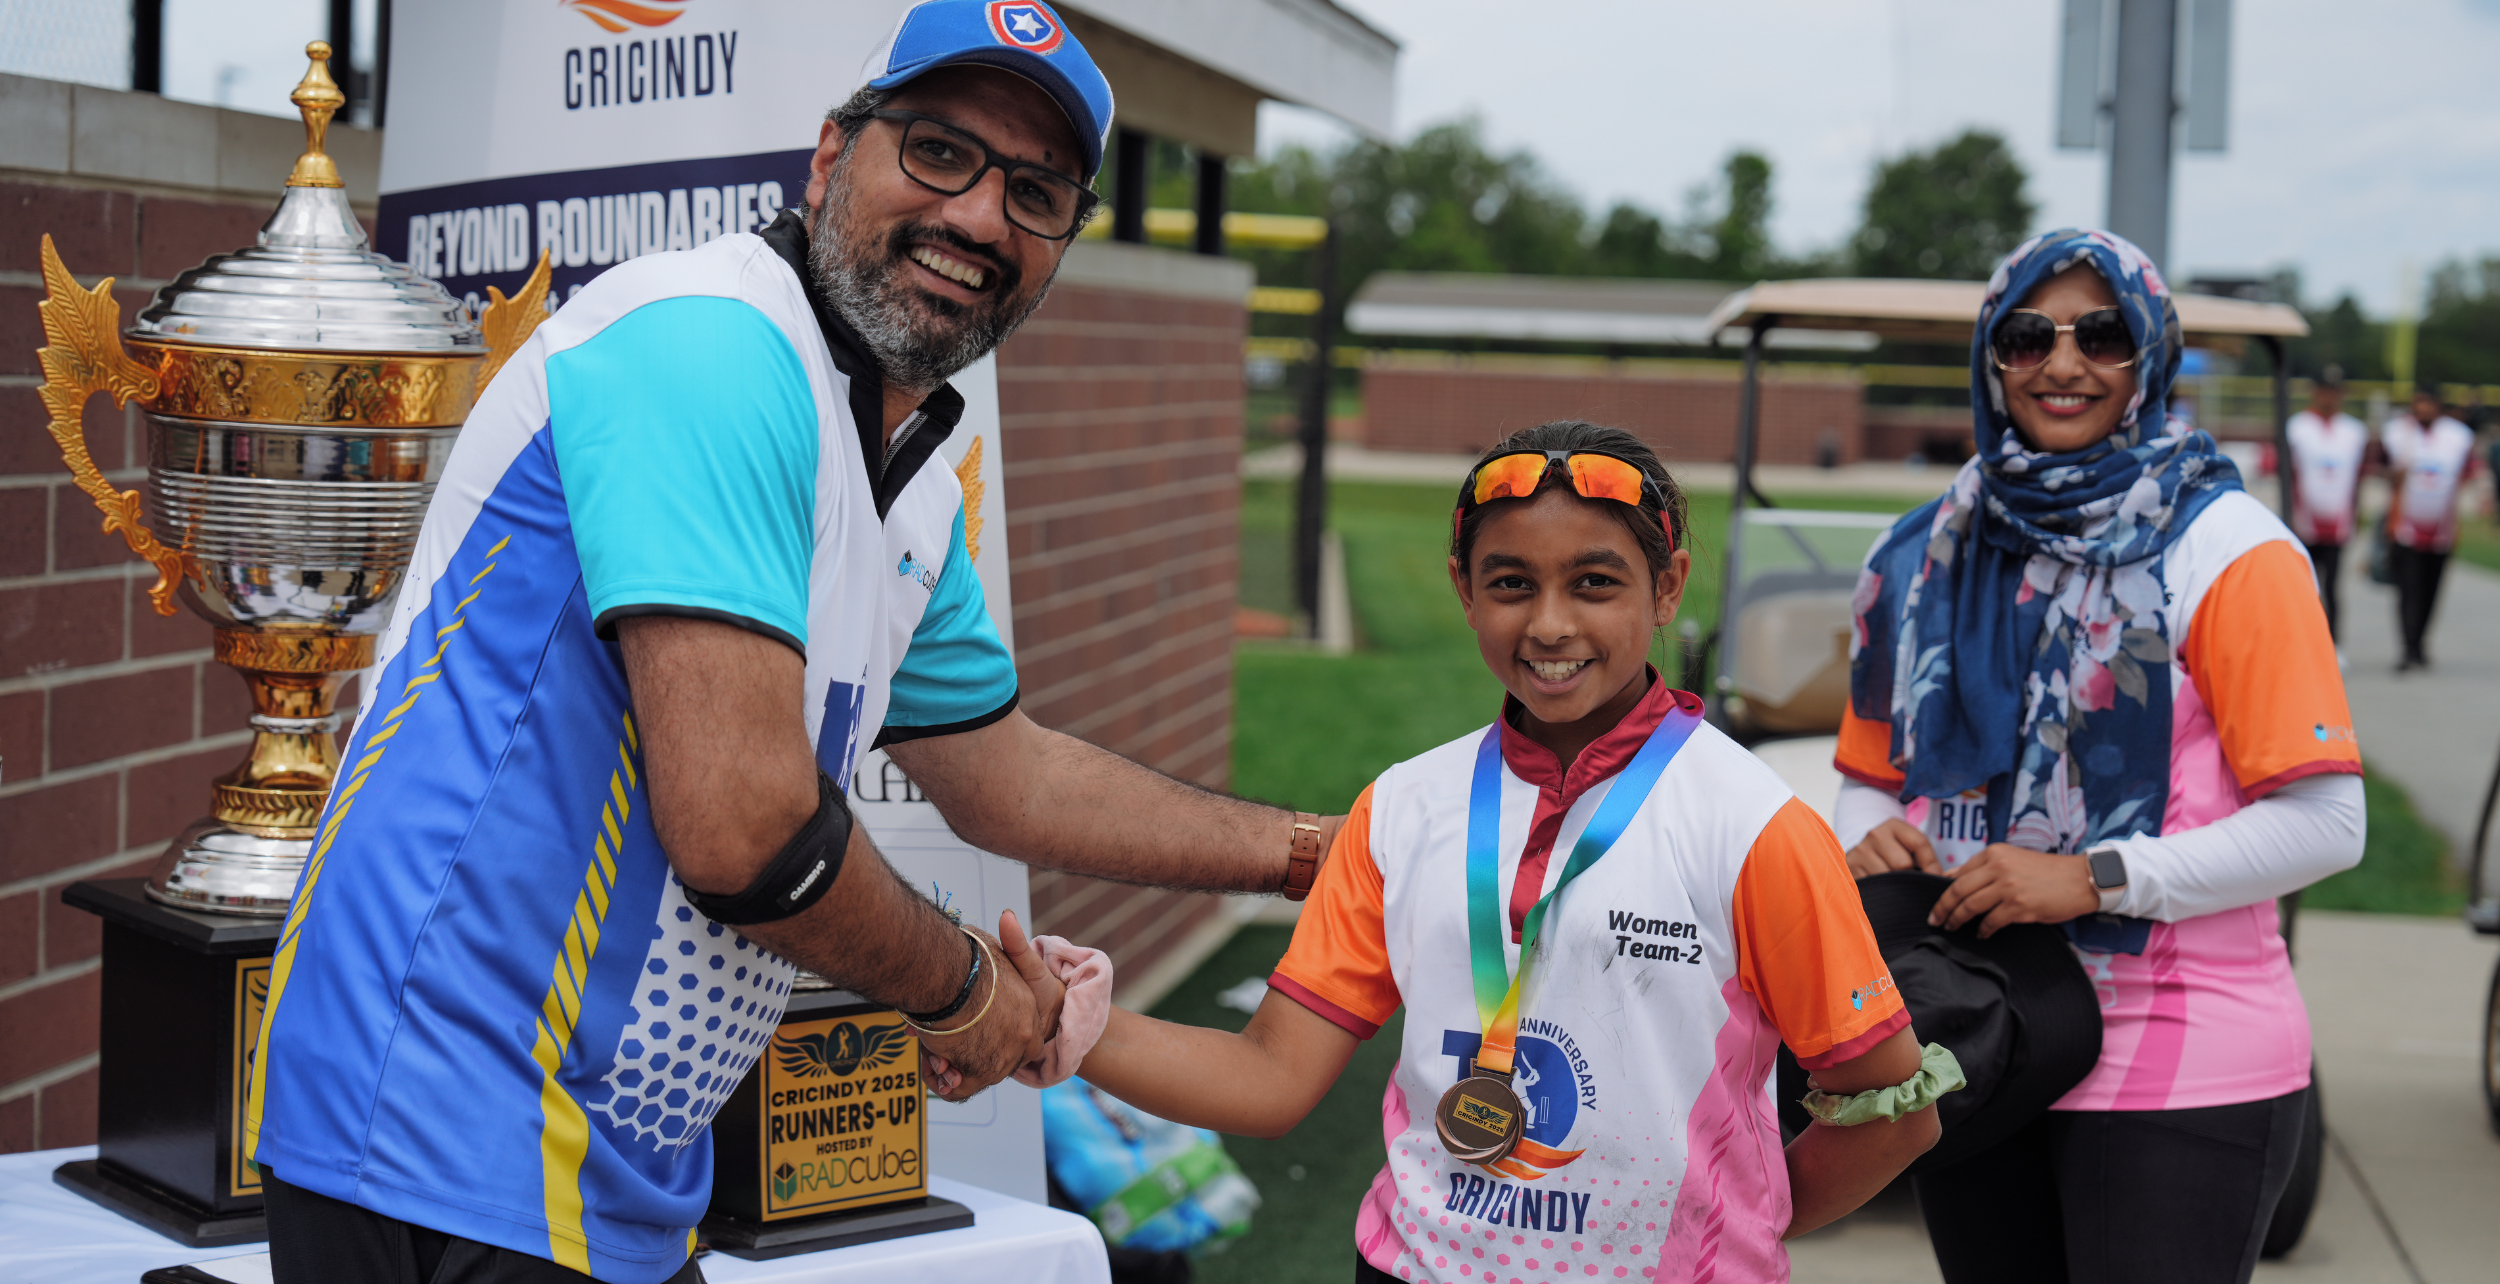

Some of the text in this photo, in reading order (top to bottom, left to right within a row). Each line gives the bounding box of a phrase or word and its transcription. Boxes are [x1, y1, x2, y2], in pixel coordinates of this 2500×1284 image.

[565, 30, 737, 110] CRICINDY
[407, 181, 784, 279] BEYOND BOUNDARIES
[1609, 909, 1698, 940] Women
[1616, 935, 1702, 965] Team-2
[1519, 1017, 1597, 1110] ANNIVERSARY
[771, 1072, 917, 1107] CRICINDY 2025
[771, 1095, 917, 1144] RUNNERS-UP
[1457, 1110, 1489, 1126] CRICINDY
[816, 1136, 874, 1156] HOSTED BY
[1445, 1172, 1591, 1235] CRICINDY
